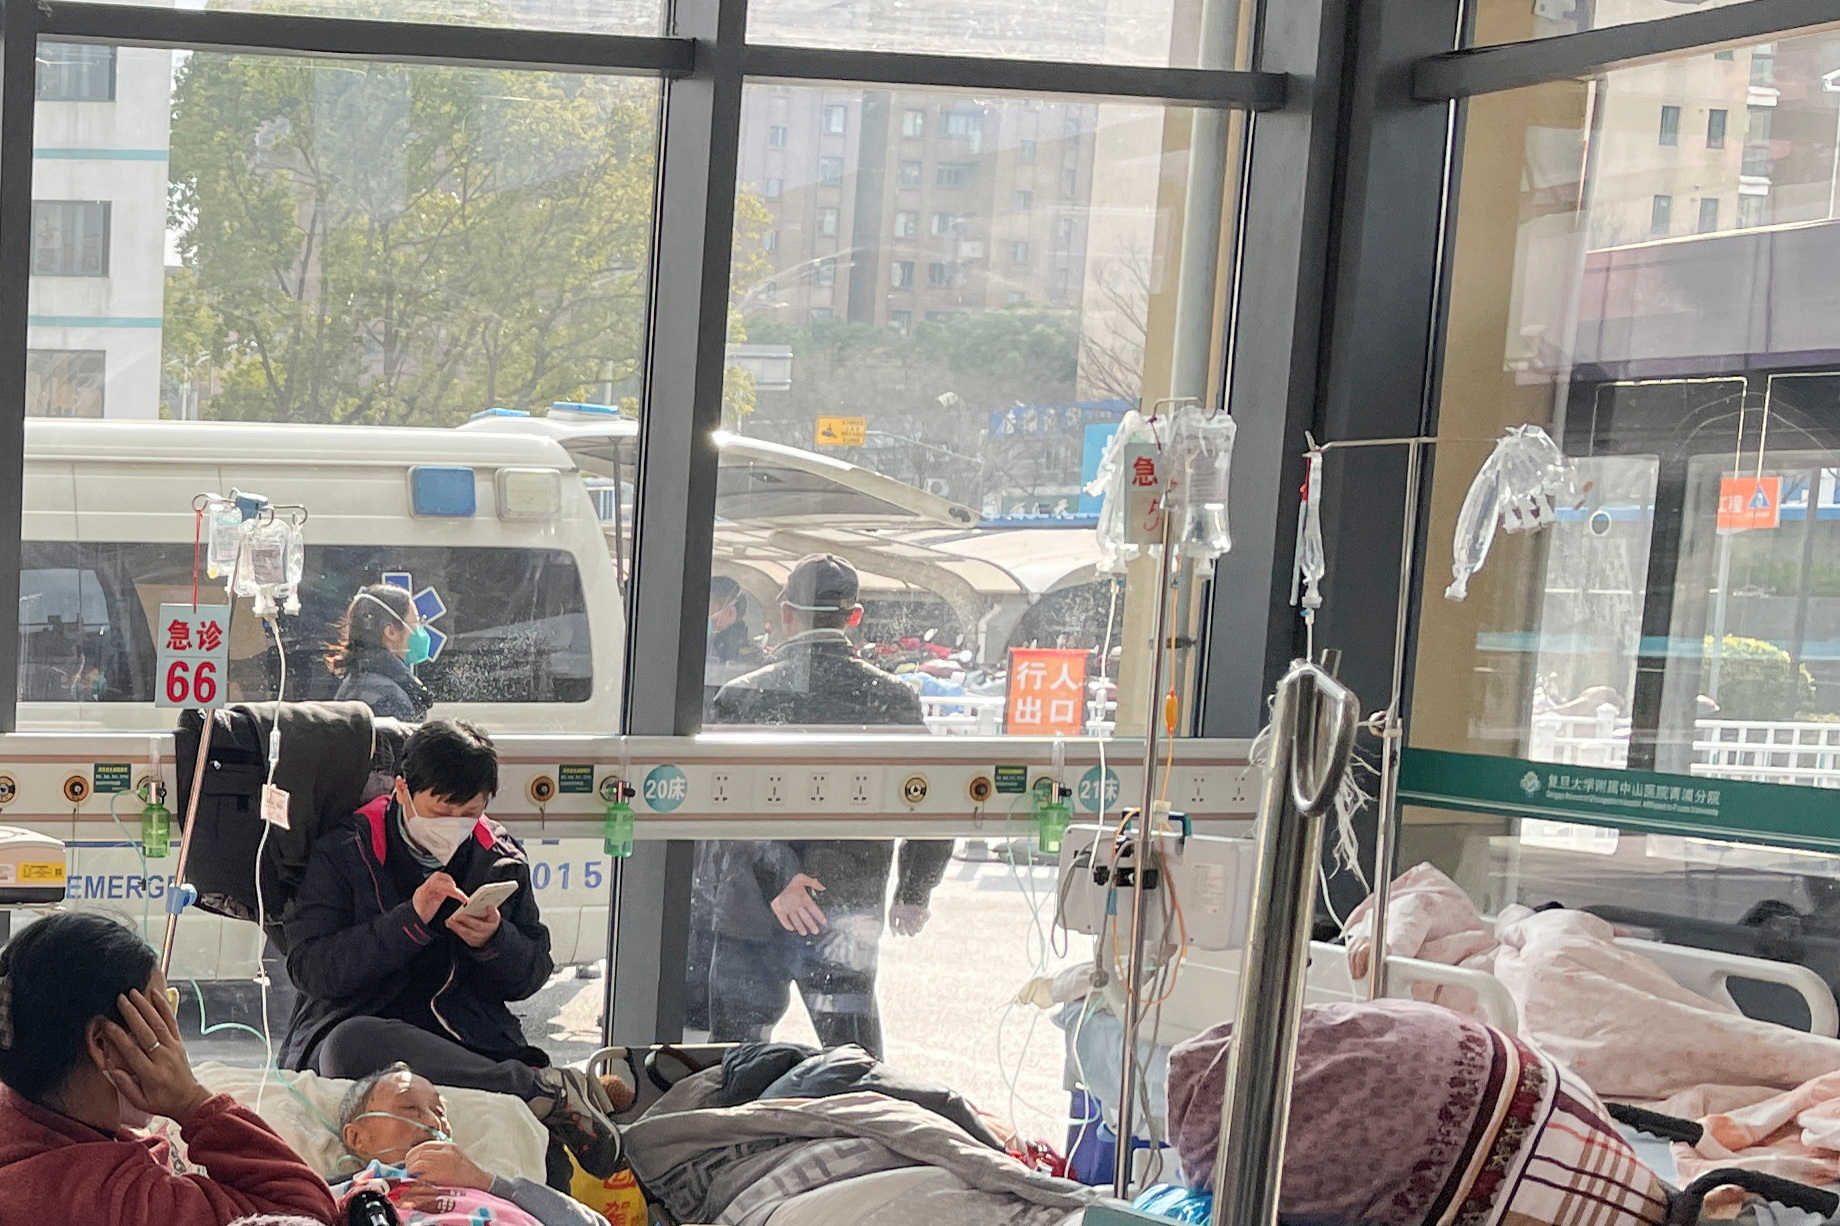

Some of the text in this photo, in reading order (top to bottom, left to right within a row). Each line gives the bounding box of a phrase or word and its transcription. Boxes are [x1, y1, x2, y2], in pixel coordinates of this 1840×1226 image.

[165, 618, 224, 653] 急诊
[165, 660, 218, 704] 66
[1016, 660, 1079, 692] 行人
[1014, 696, 1076, 725] 出口
[645, 776, 687, 802] 20床
[1079, 777, 1119, 801] 21床
